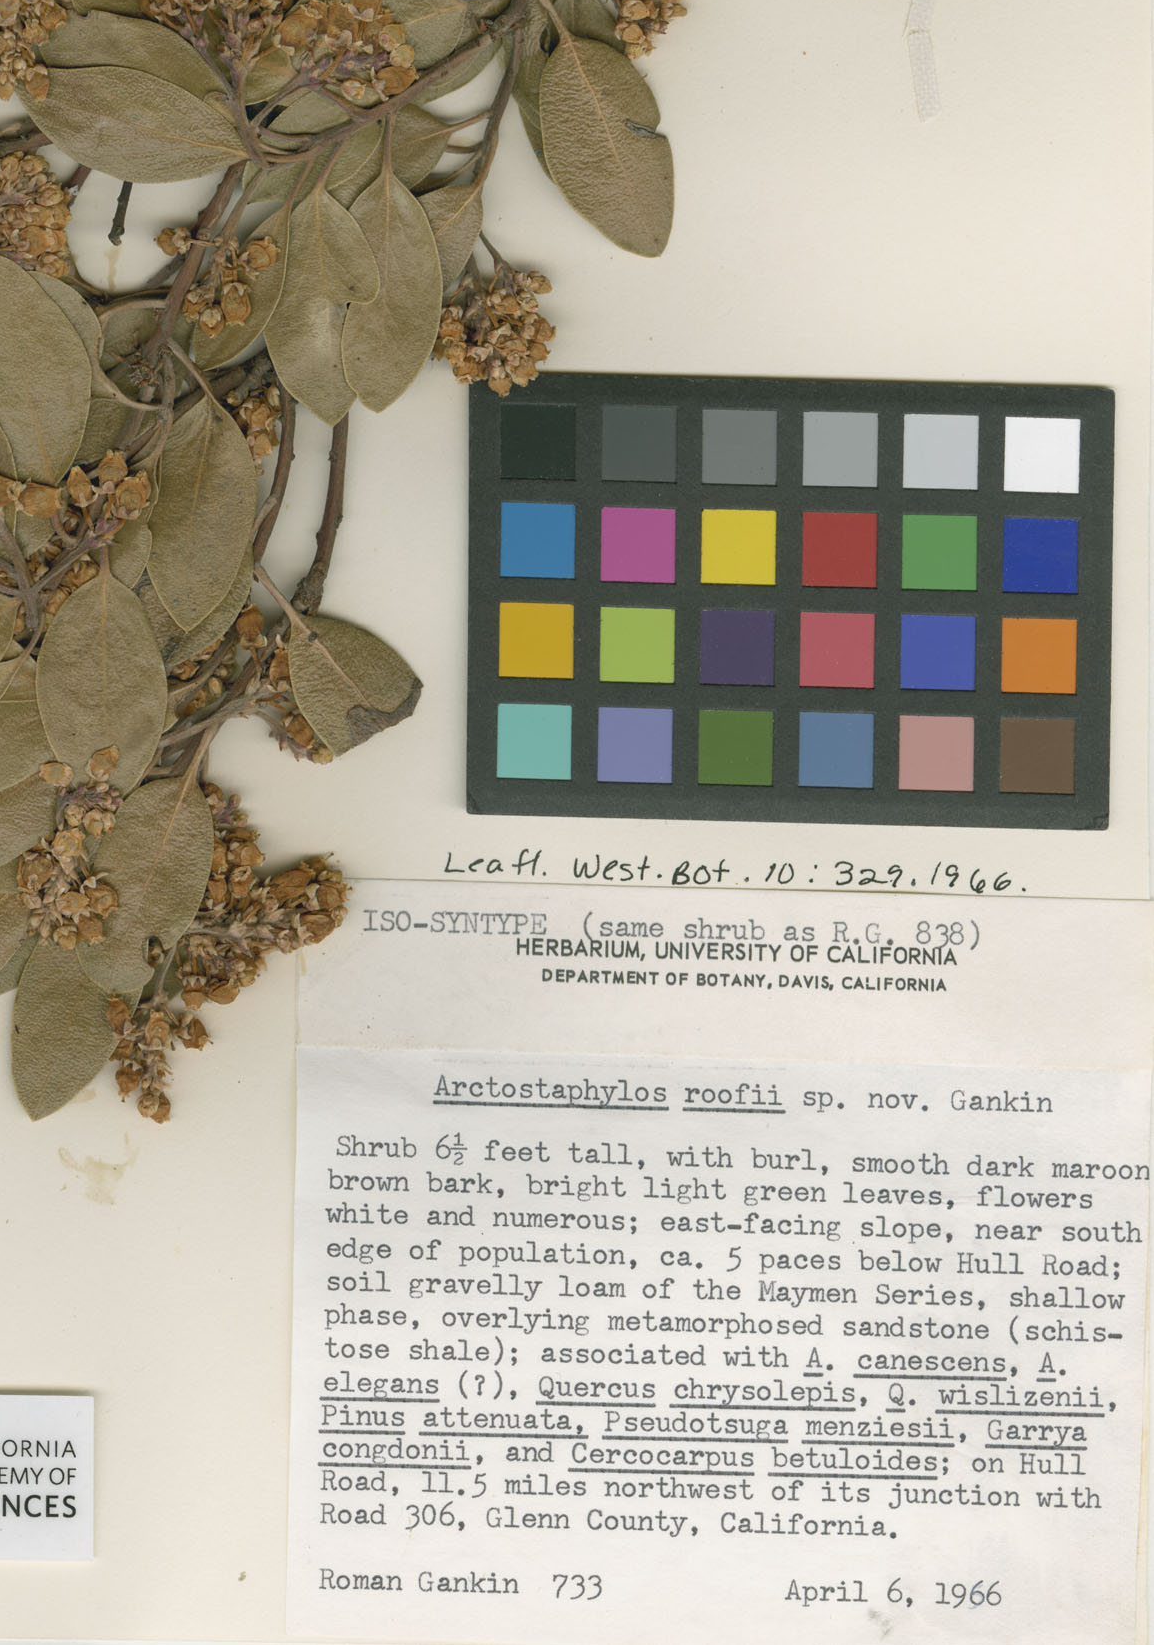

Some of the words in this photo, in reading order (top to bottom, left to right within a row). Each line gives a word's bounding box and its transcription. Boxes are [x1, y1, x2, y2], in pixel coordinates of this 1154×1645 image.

[362, 909, 548, 935] ISO-SYNTYPE
[583, 911, 664, 941] (same
[684, 917, 765, 941] shrub
[783, 924, 816, 943] as
[831, 921, 895, 945] R.G.
[915, 919, 980, 951] 838)
[516, 937, 646, 962] HERBARIUM,
[655, 940, 782, 963] UNIVERSITY
[789, 944, 819, 963] OF
[827, 945, 958, 966] CALIFORNIA
[542, 968, 659, 985] DEPARTMENT
[665, 972, 689, 986] OF
[696, 973, 772, 990] BOTANY,
[779, 974, 834, 991] DAVIS,
[842, 976, 947, 992] CALIFORNIA
[434, 1076, 670, 1106] Arctostaphylos
[684, 1083, 782, 1106] roofii
[803, 1091, 844, 1113] sp.
[867, 1092, 929, 1112] nov.
[951, 1090, 1053, 1113] Gankin
[336, 1134, 417, 1158] Shrub
[484, 1139, 550, 1162] feet
[568, 1142, 645, 1170] tall,
[666, 1145, 733, 1168] with
[751, 1147, 828, 1176] burl,
[852, 1152, 950, 1175] smooth
[967, 1154, 1034, 1177] dark
[1051, 1163, 1150, 1180] maroon
[327, 1168, 410, 1192] brown
[426, 1171, 504, 1198] bark,
[526, 1173, 626, 1202] bright
[643, 1176, 726, 1204] light
[744, 1185, 827, 1206] green
[843, 1181, 954, 1210] leaves,
[976, 1185, 1092, 1209] flowers
[325, 1201, 408, 1225] white
[427, 1205, 476, 1226] and
[492, 1212, 637, 1235] numerous;
[661, 1211, 841, 1242] east-facing
[861, 1215, 953, 1244] slope,
[975, 1224, 1042, 1241] near
[1062, 1221, 1142, 1243] south
[327, 1237, 392, 1264] edge
[409, 1239, 442, 1260] of
[458, 1241, 637, 1270] population,
[660, 1251, 703, 1270] ca.
[726, 1246, 741, 1272] 5
[759, 1254, 841, 1275] paces
[858, 1249, 943, 1273] below
[957, 1252, 1024, 1275] Hull
[1042, 1254, 1120, 1280] Road;
[327, 1270, 391, 1292] soil
[409, 1273, 543, 1302] gravelly
[559, 1275, 626, 1298] loam
[642, 1277, 675, 1299] of
[693, 1278, 741, 1300] the
[758, 1280, 858, 1308] Maymen
[875, 1284, 985, 1311] Series,
[1010, 1285, 1126, 1310] shallow
[324, 1302, 419, 1330] phase,
[442, 1307, 589, 1336] overlying
[607, 1310, 824, 1339] metamorphosed
[843, 1316, 989, 1339] sandstone
[1009, 1315, 1123, 1345] (schis-
[324, 1337, 389, 1359] tose
[409, 1336, 517, 1366] shale);
[541, 1343, 706, 1366] associated
[723, 1345, 789, 1368] with
[805, 1348, 833, 1373] A.
[855, 1355, 1018, 1377] canescens,
[1038, 1353, 1066, 1377] A.
[321, 1371, 440, 1398] elegans
[459, 1370, 517, 1400] (?),
[537, 1377, 656, 1403] Quercus
[671, 1378, 867, 1407] chrysolepis,
[887, 1383, 916, 1408] Q.
[937, 1384, 1116, 1413] wislizenii,
[320, 1405, 406, 1430] Pinus
[420, 1407, 589, 1435] attenuata,
[604, 1411, 789, 1439] Pseudotsuga
[803, 1417, 966, 1443] menziesii,
[986, 1420, 1088, 1446] Garrya
[49, 1467, 76, 1485] OF
[319, 1438, 483, 1465] congdonii,
[506, 1441, 554, 1462] and
[569, 1443, 755, 1472] Cercocarpus
[771, 1448, 949, 1475] betuloides;
[972, 1457, 1004, 1473] on
[1019, 1452, 1086, 1475] Hull
[320, 1469, 399, 1496] Road,
[504, 1473, 587, 1496] miles
[604, 1476, 754, 1500] northwest
[771, 1479, 804, 1501] of
[821, 1481, 870, 1503] its
[888, 1482, 1020, 1509] junction
[1035, 1487, 1102, 1509] with
[320, 1503, 387, 1525] Road
[405, 1501, 465, 1532] 306,
[486, 1506, 571, 1529] Glenn
[587, 1508, 698, 1538] County,
[721, 1511, 897, 1539] California.
[319, 1568, 403, 1591] Roman
[418, 1571, 520, 1594] Gankin
[553, 1574, 602, 1600] 733
[784, 1579, 868, 1607] April
[887, 1577, 913, 1608] 6,
[935, 1580, 1002, 1609] 1966
